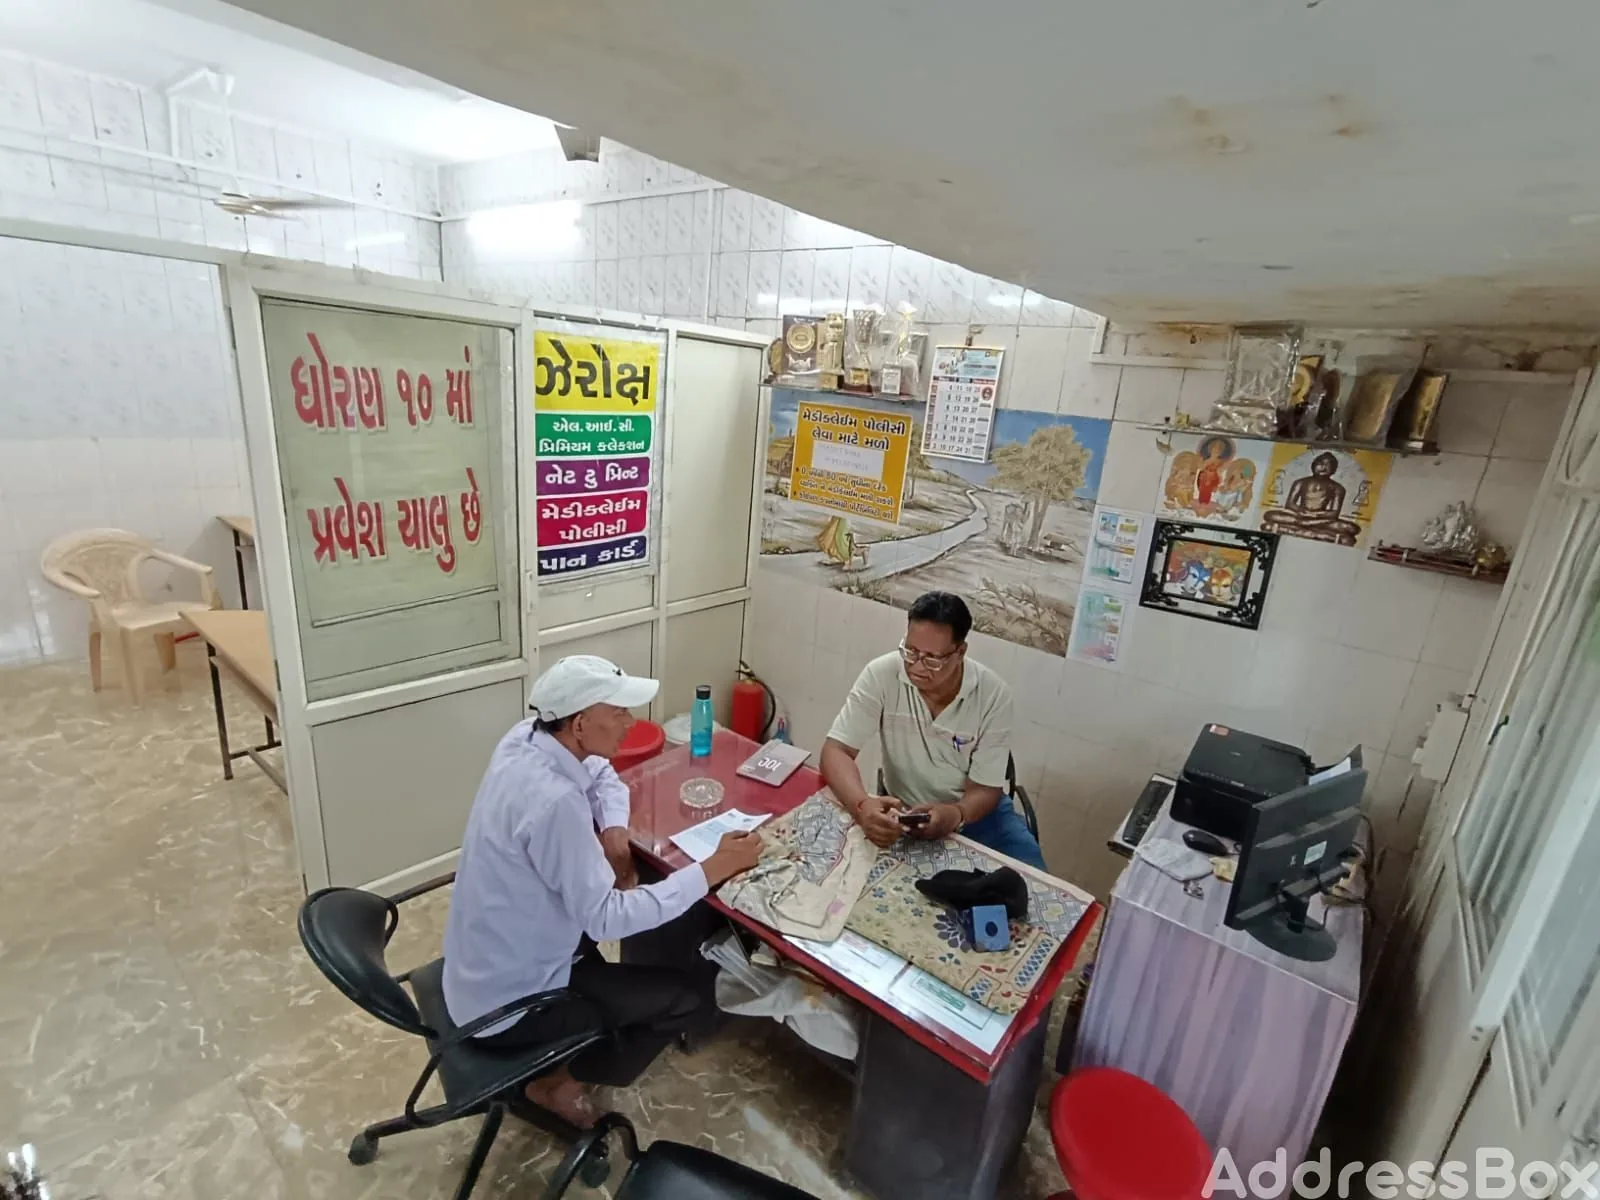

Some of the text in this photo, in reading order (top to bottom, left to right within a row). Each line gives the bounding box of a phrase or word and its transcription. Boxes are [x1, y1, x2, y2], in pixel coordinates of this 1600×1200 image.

[291, 332, 385, 428] ધોરણ
[446, 345, 474, 424] માં
[535, 338, 650, 406] ઝેરોક્ષ
[803, 408, 905, 435] મેડીકલેઈમ પોલીસી
[540, 438, 590, 453] પ્રિમિયમ
[812, 426, 833, 441] લેવા
[839, 431, 858, 445] માટે
[865, 437, 890, 451] મળો
[545, 462, 639, 489] નેટ ટુ પ્રિન્ટ
[307, 467, 480, 573] પ્રવેશ ચાલુ છે
[541, 497, 641, 519] મેડીકલેઈમ
[559, 518, 627, 541] પોલીસી
[540, 539, 639, 570] પાન કાર્ડ
